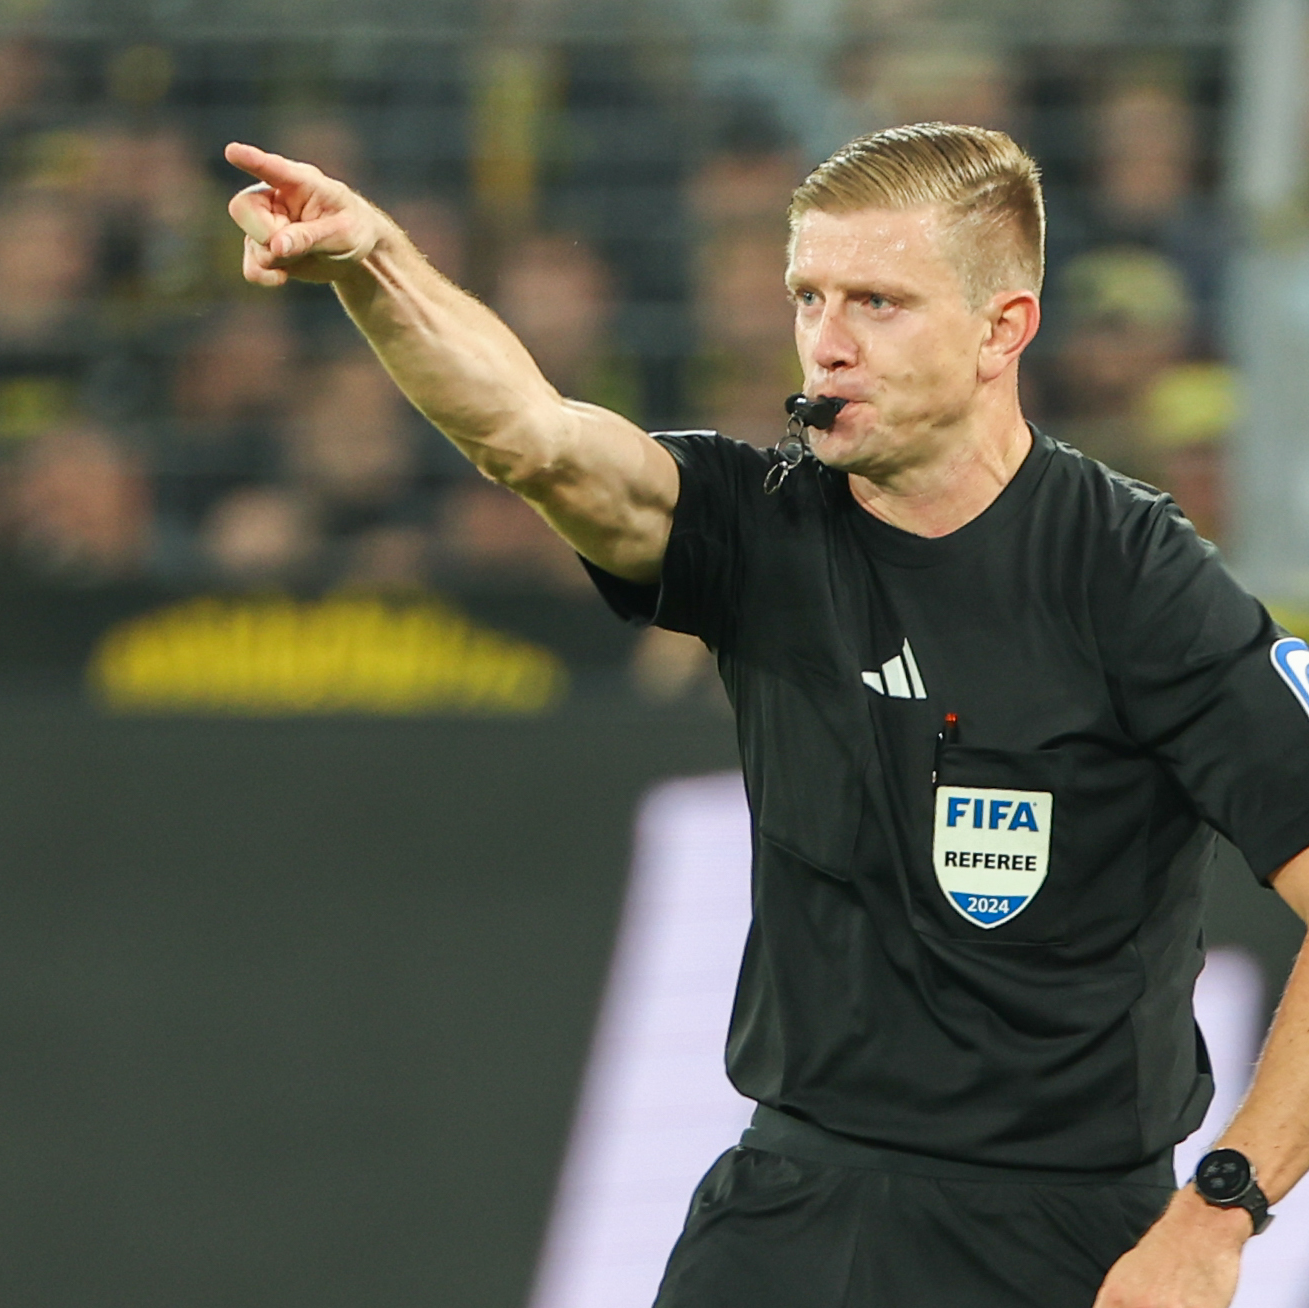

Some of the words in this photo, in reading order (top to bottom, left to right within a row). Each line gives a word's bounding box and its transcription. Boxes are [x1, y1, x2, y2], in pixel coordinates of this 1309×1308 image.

[946, 797, 1039, 832] FIFA
[944, 851, 1037, 871] REFEREE
[967, 897, 1010, 914] 2024
